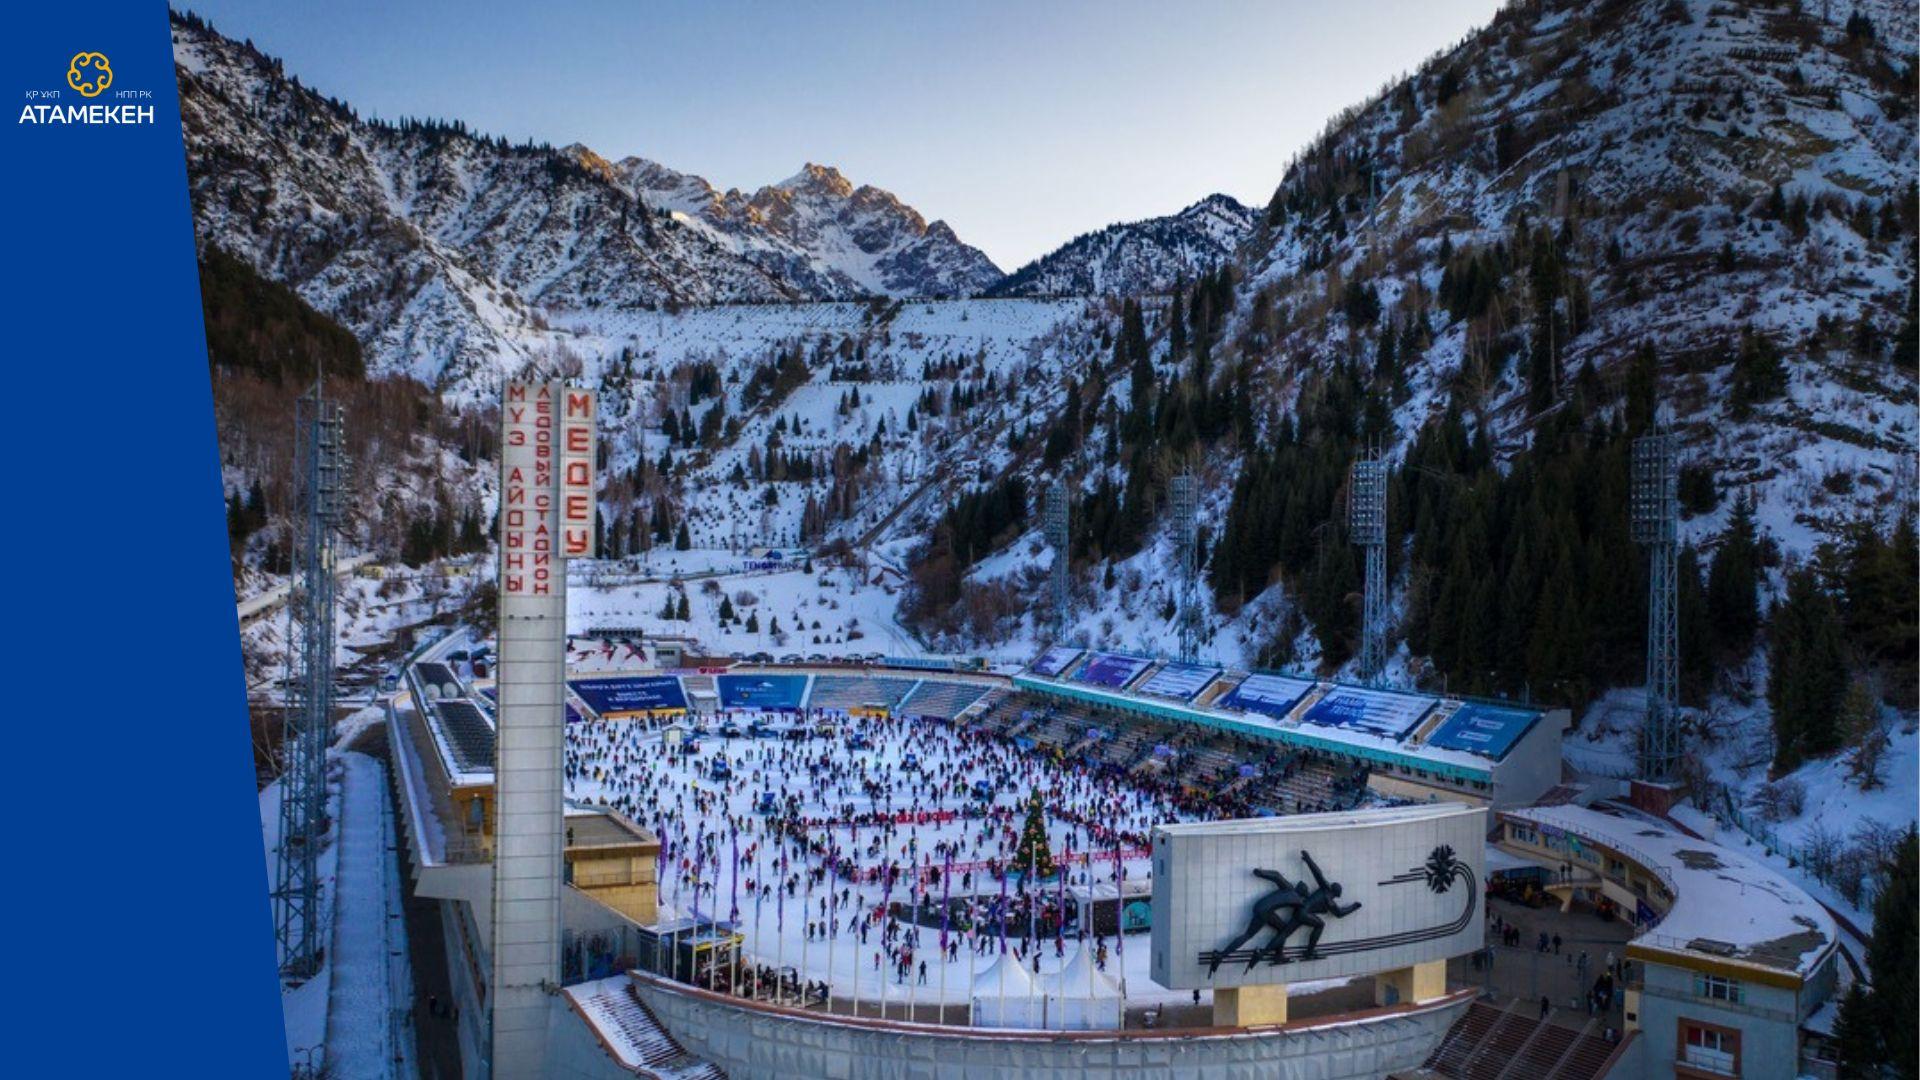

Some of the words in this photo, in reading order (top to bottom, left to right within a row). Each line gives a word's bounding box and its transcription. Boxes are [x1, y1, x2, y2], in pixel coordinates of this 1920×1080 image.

[535, 386, 551, 487] ЛЕДОВЫЙ
[566, 392, 589, 553] МЕДЕУ
[506, 466, 524, 592] АЙДЫНЫ
[534, 494, 551, 594] СТАДИОН
